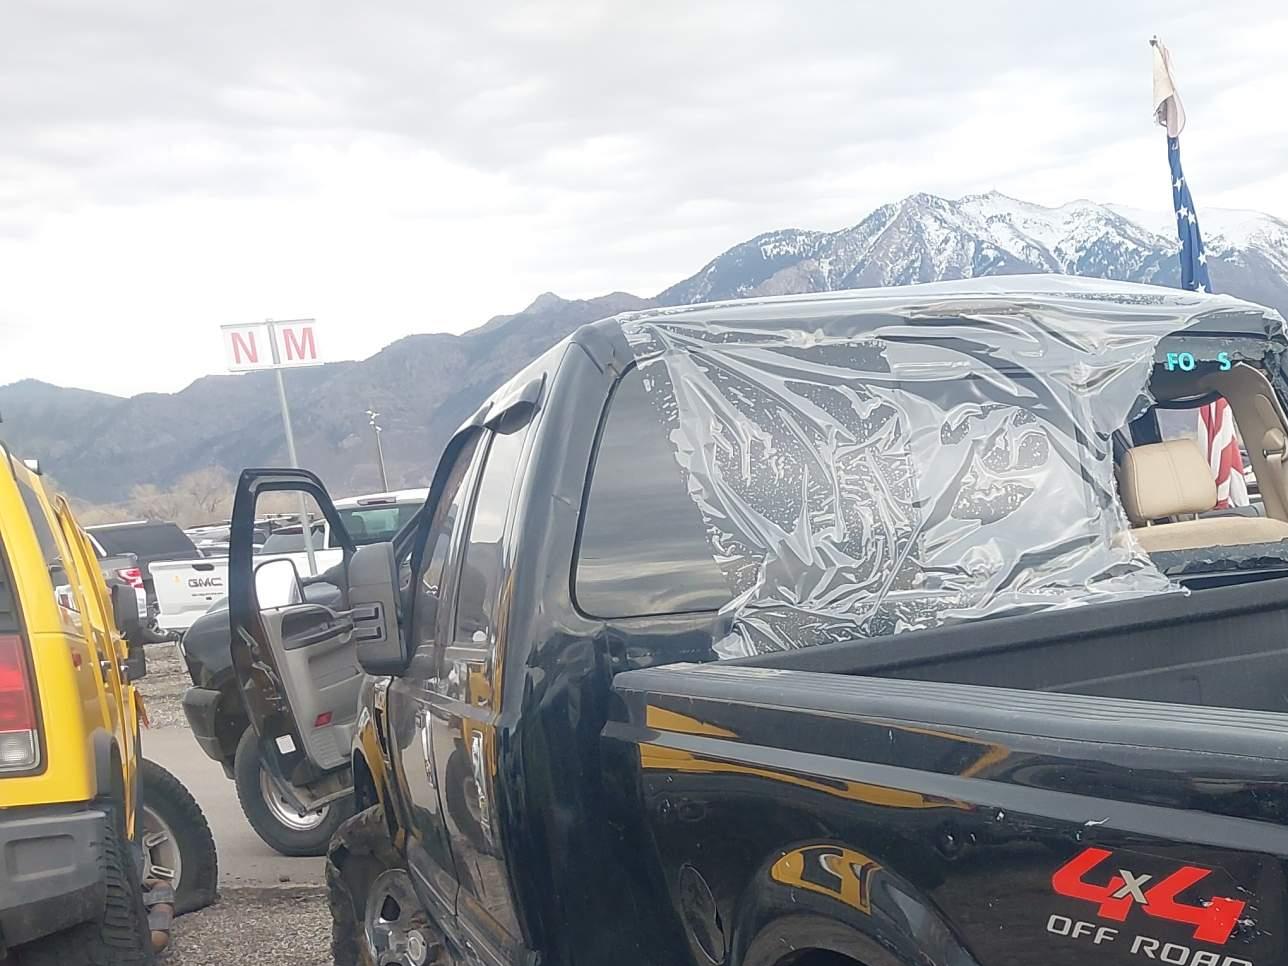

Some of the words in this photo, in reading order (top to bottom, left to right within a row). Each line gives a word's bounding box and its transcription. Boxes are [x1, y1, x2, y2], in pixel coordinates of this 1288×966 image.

[231, 331, 258, 364] N
[283, 327, 316, 360] M
[1217, 352, 1231, 371] S
[188, 577, 223, 588] GMC
[1047, 914, 1119, 944] OFF
